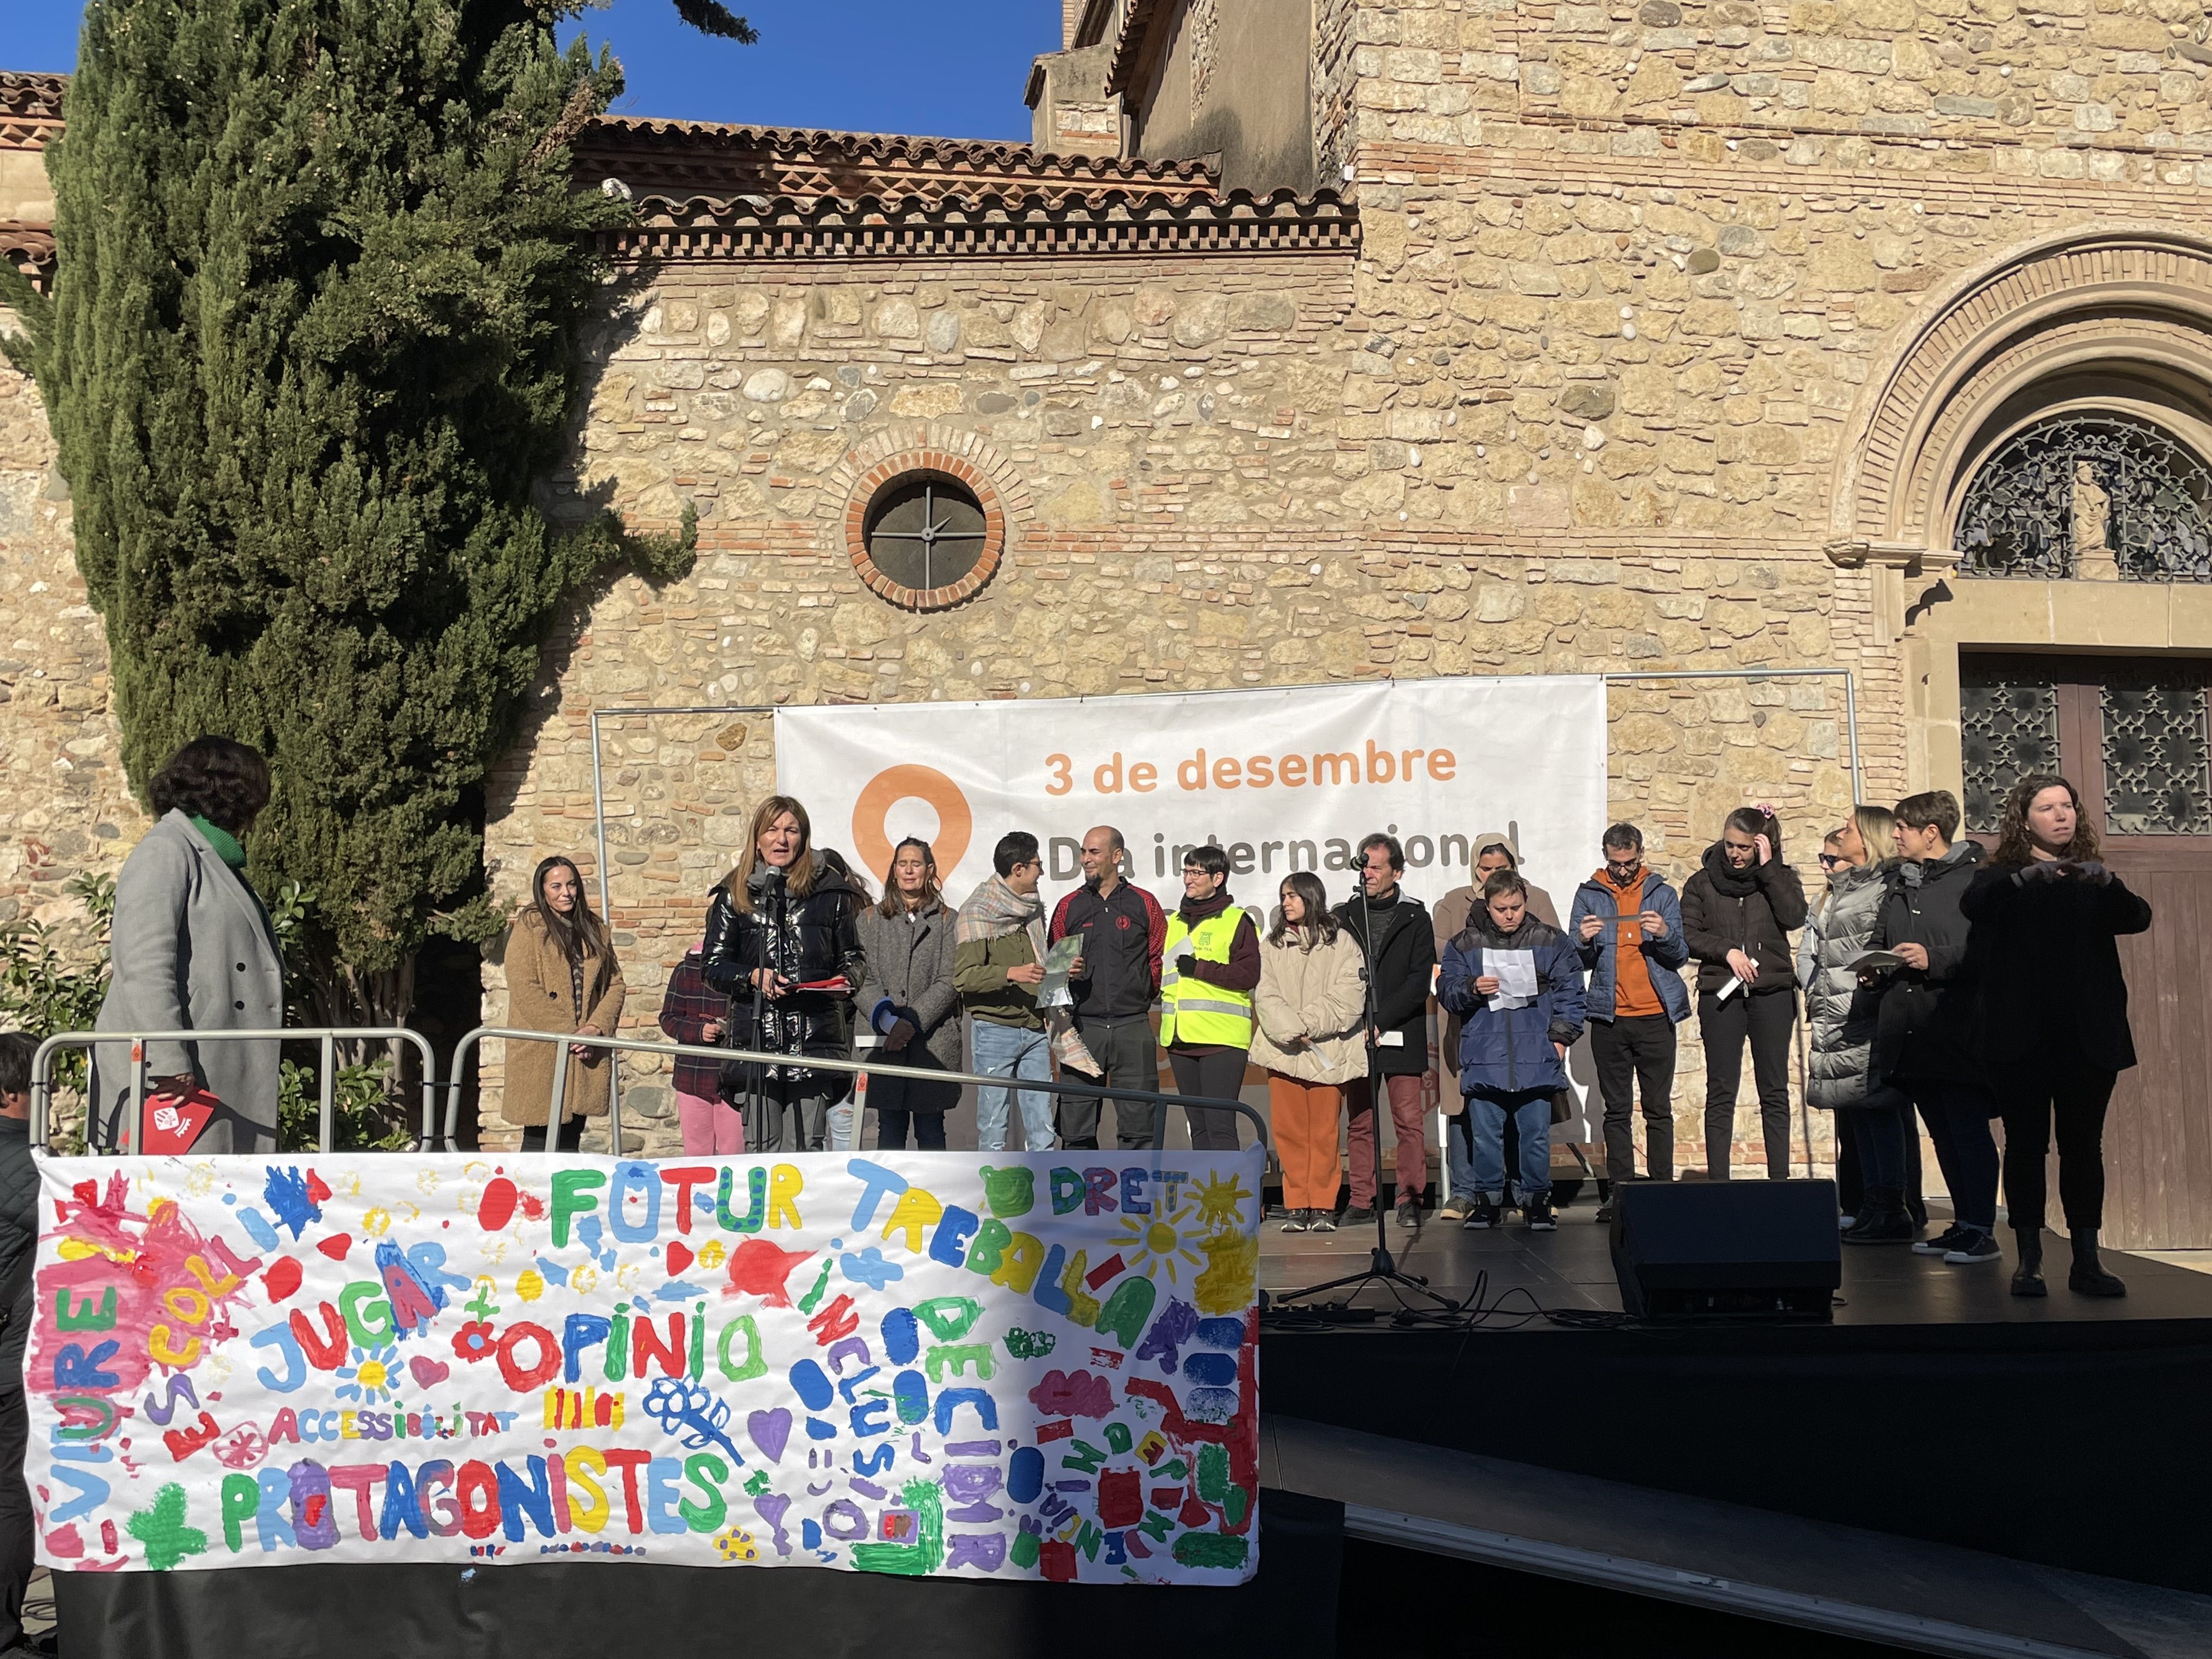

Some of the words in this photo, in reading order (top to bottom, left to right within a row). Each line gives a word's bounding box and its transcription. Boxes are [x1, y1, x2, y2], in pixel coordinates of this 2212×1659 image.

[1045, 753, 1073, 796] 3
[1093, 752, 1158, 794] de
[1177, 739, 1456, 791] desembre
[1050, 1166, 1189, 1216] DRET
[250, 1239, 472, 1393] JUGAR
[50, 1286, 121, 1523] VIURE
